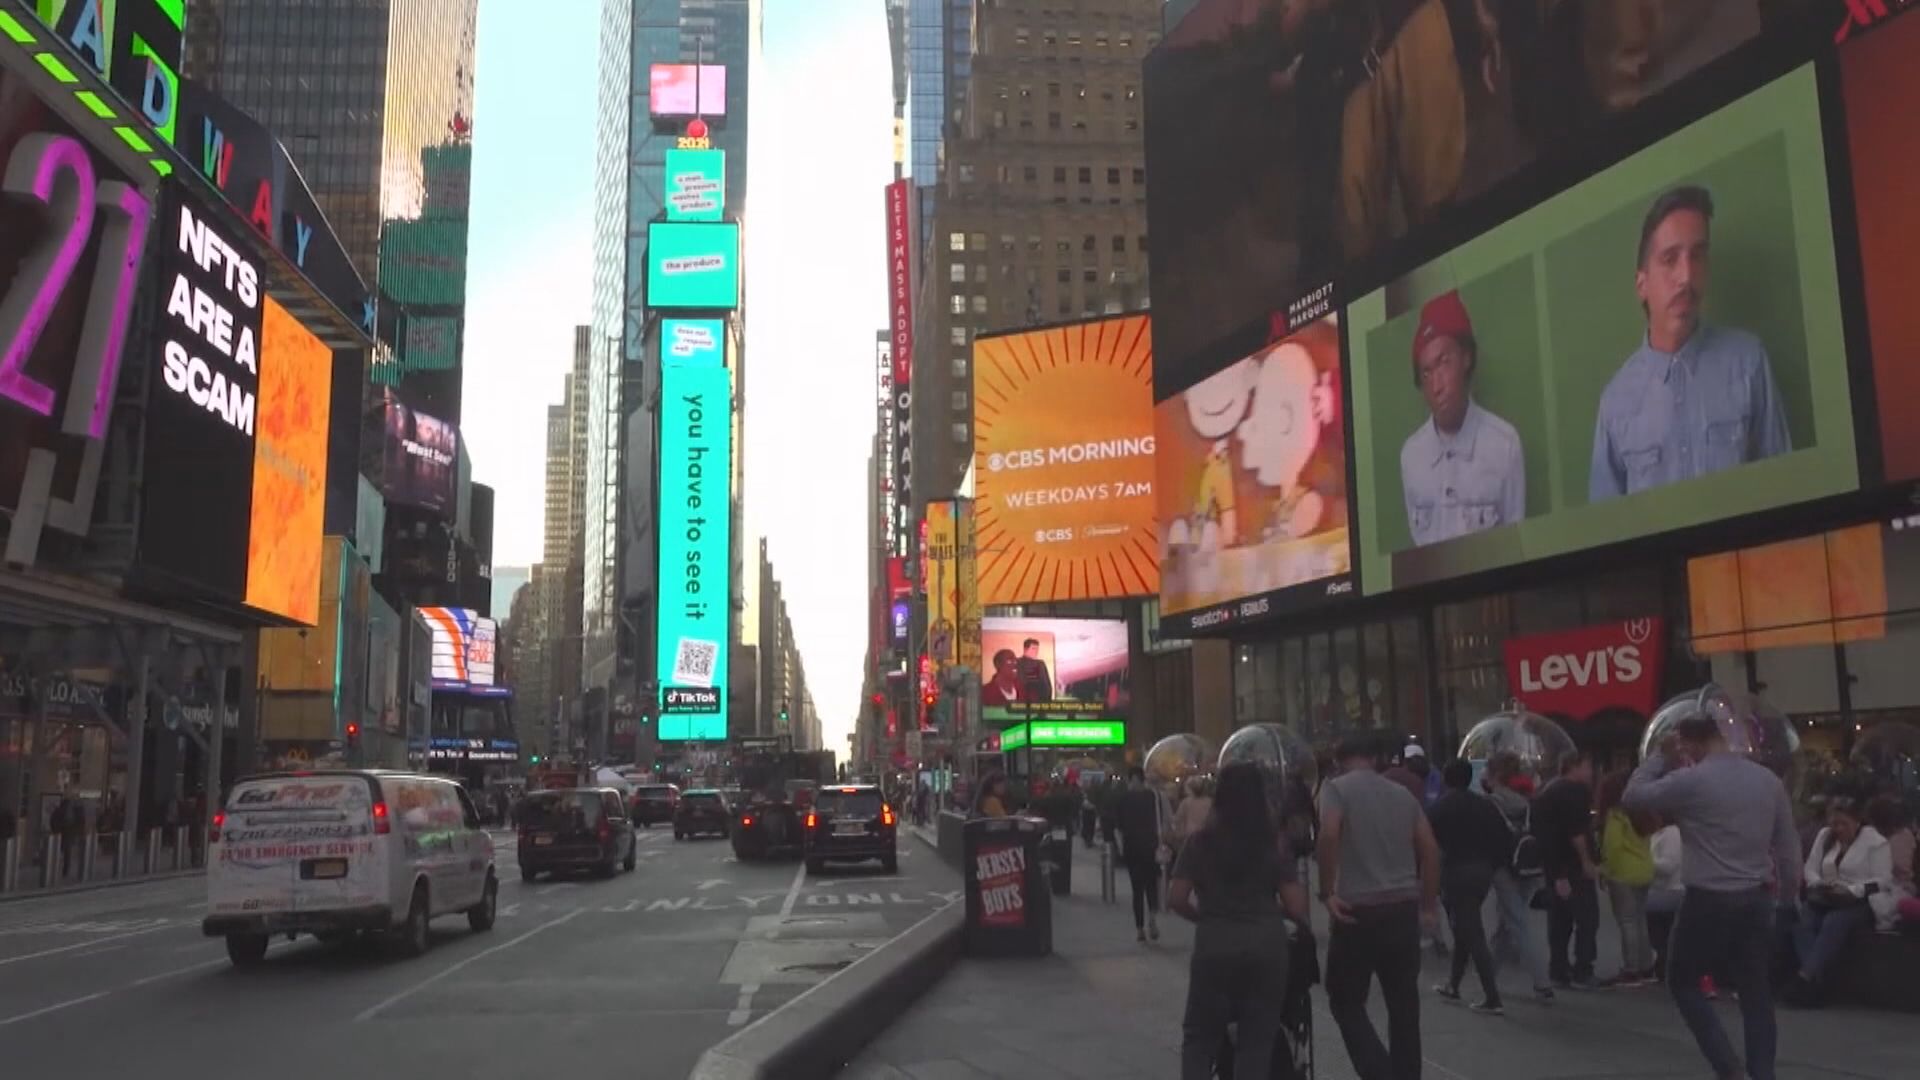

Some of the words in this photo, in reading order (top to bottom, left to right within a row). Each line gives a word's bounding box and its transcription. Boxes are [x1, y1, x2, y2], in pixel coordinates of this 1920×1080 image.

[894, 189, 903, 240] LETS
[179, 204, 258, 308] NFTS
[683, 258, 721, 271] produce
[895, 246, 905, 298] MASS
[1289, 282, 1333, 314] MARRIOTT
[1289, 300, 1329, 329] MARQUIS
[167, 273, 234, 357] ARE
[235, 325, 257, 375] A
[897, 305, 908, 371] ADOPT
[163, 340, 255, 436] SCAM
[683, 395, 703, 438] you
[1004, 449, 1045, 469] CBS
[687, 447, 709, 509] have
[1006, 483, 1109, 508] WEEKDAYS
[1114, 481, 1152, 497] 7AM
[686, 517, 706, 542] to
[1046, 528, 1073, 541] CBS
[685, 550, 701, 594] see
[685, 603, 707, 620] it
[680, 693, 717, 703] TikTok
[976, 846, 1026, 880] JERSEY
[806, 890, 965, 912] ONLY
[982, 883, 1023, 916] BOYS
